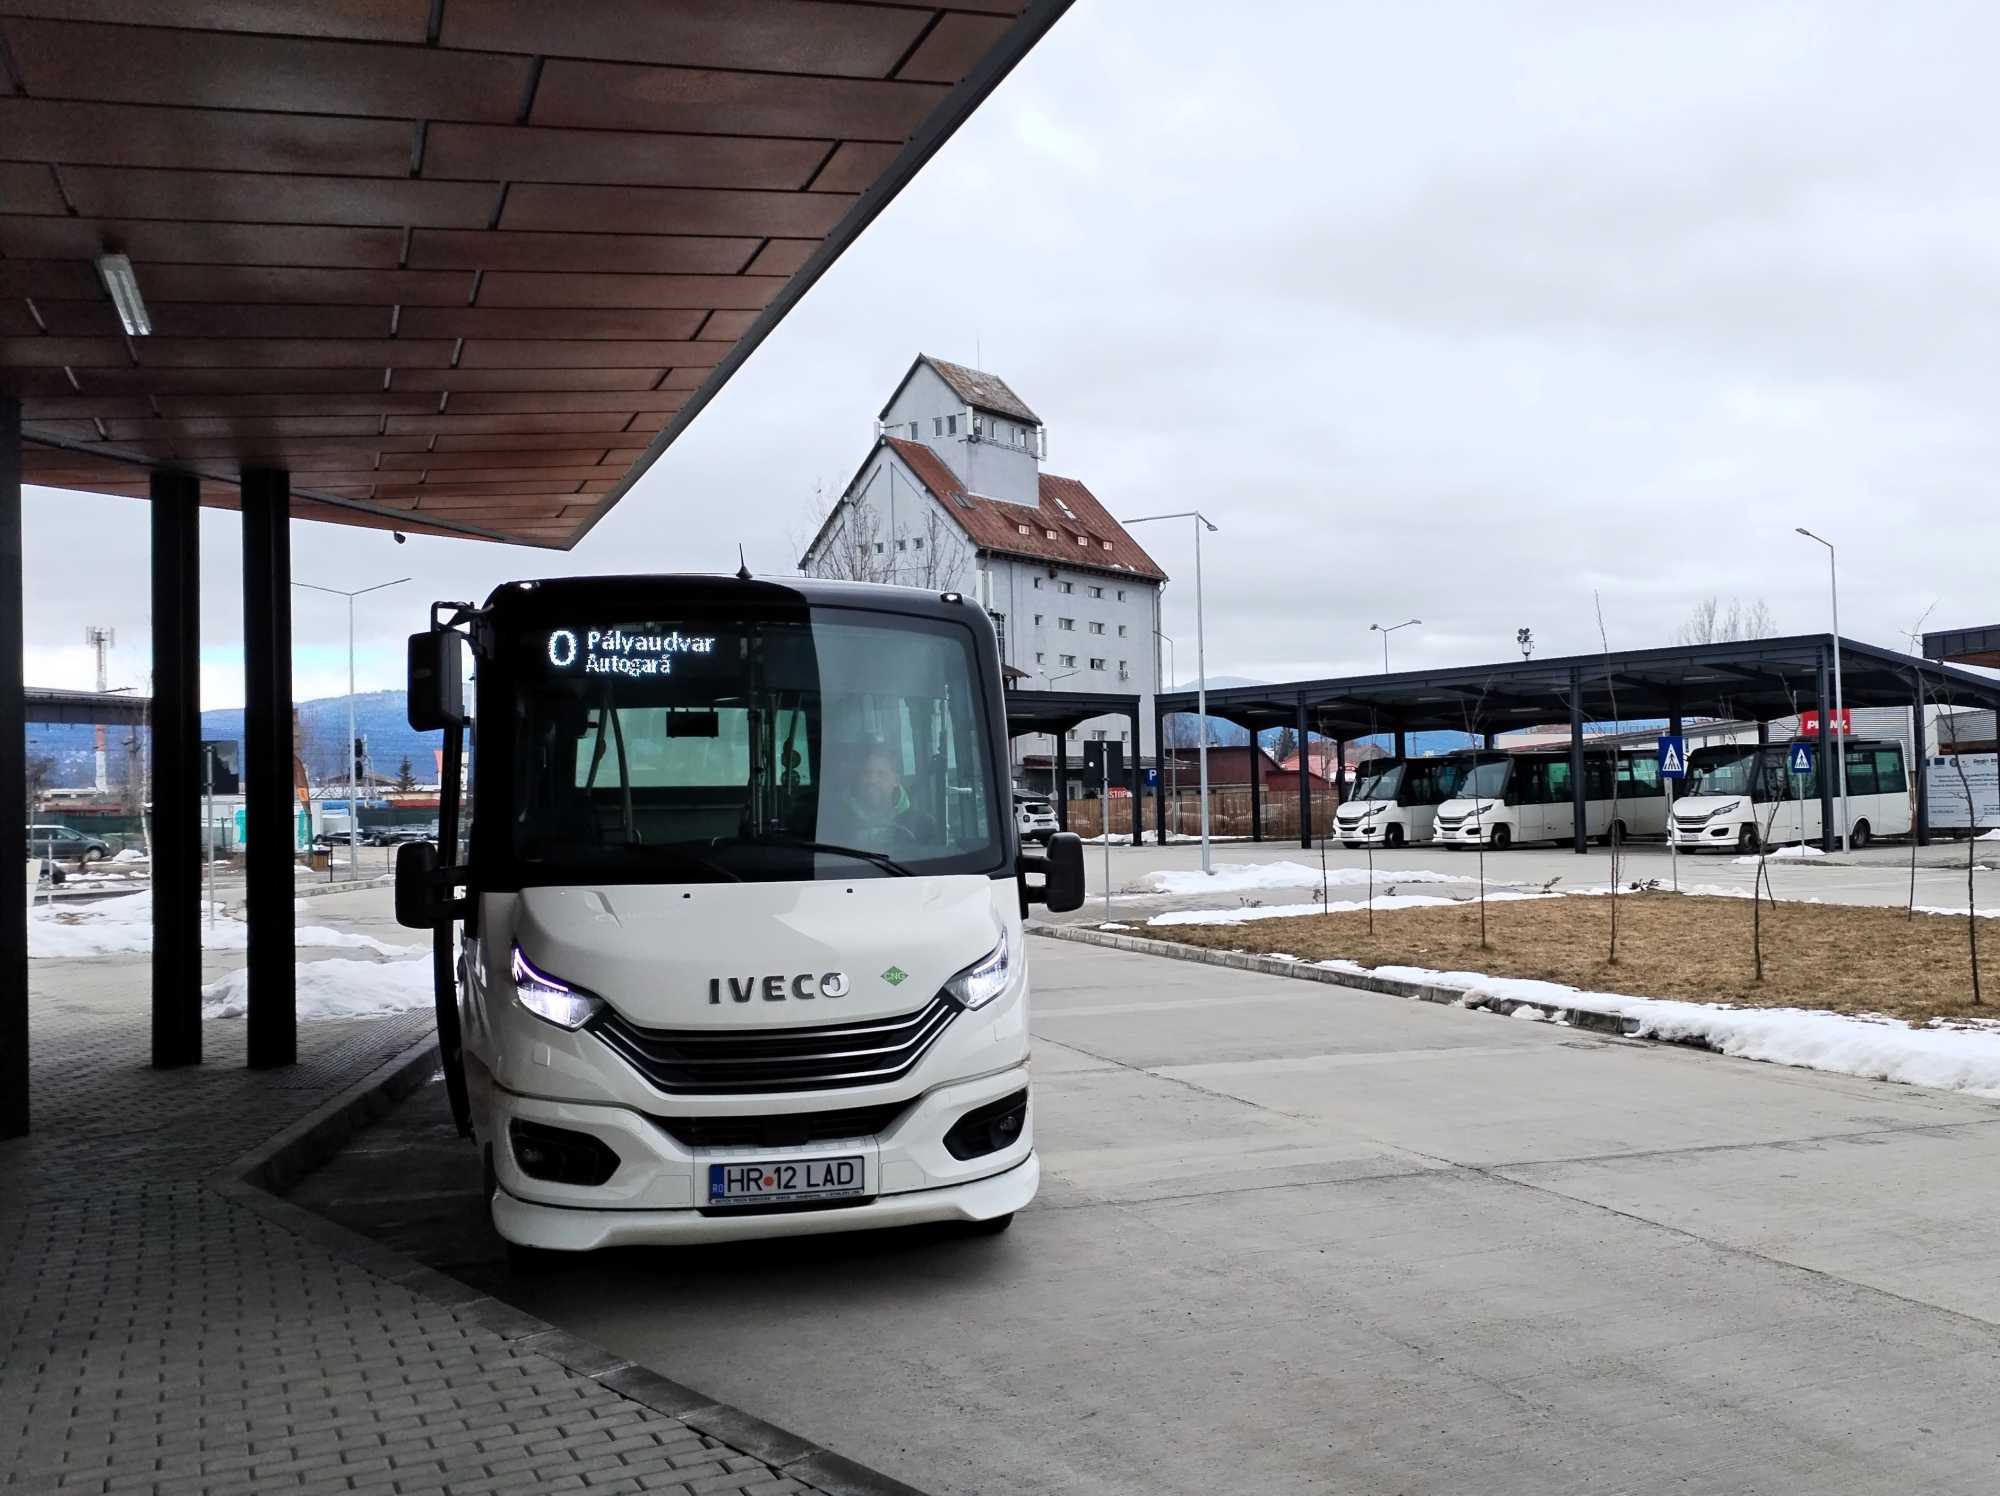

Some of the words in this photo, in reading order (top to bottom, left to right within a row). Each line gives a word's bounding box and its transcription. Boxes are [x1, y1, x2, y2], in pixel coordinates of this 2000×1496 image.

[587, 630, 716, 655] Pályaudvar
[1149, 769, 1157, 781] P
[1109, 790, 1127, 799] STOP
[708, 972, 849, 1005] IVECO
[727, 1167, 763, 1193] HR
[774, 1166, 797, 1190] 12
[806, 1161, 854, 1188] LAD
[712, 1183, 725, 1194] RO
